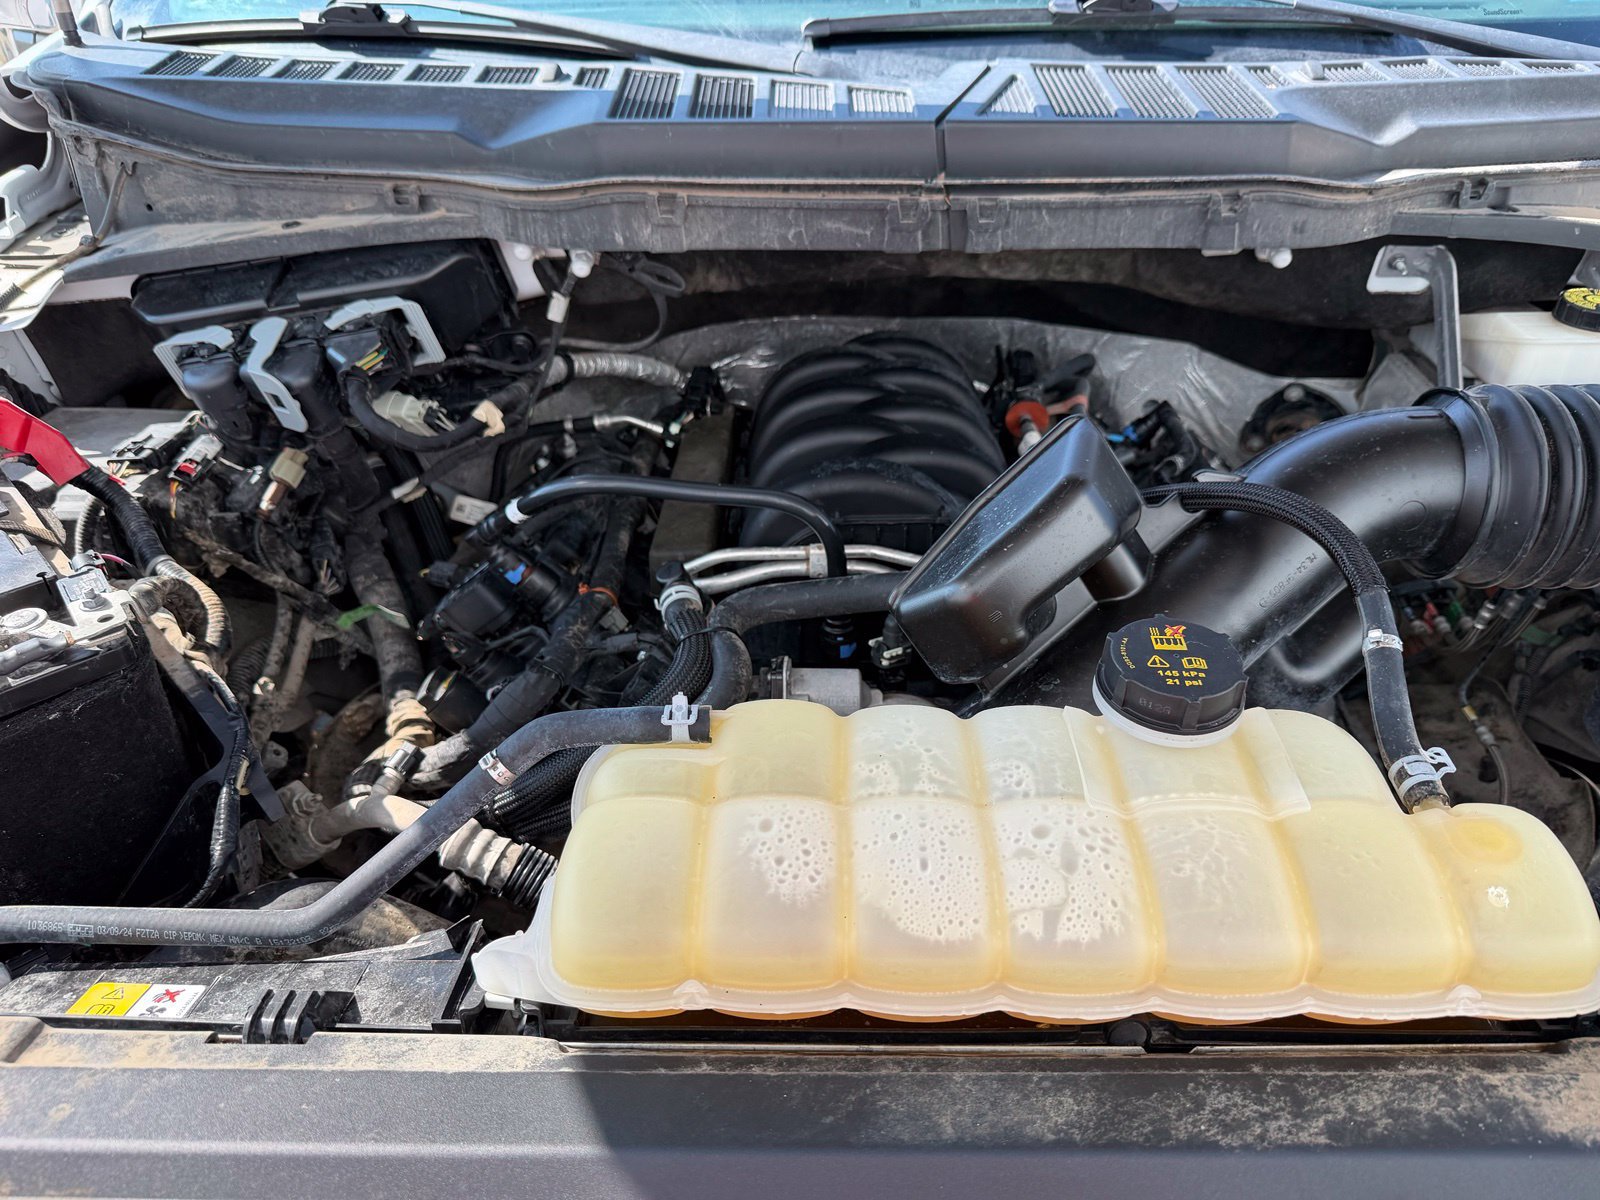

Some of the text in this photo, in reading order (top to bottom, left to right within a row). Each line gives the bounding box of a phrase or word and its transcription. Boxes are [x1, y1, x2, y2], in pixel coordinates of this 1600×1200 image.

[1182, 670, 1206, 678] kPa
[1185, 679, 1203, 687] psi
[27, 920, 63, 932] 1036865
[97, 925, 133, 938] 03/09/24
